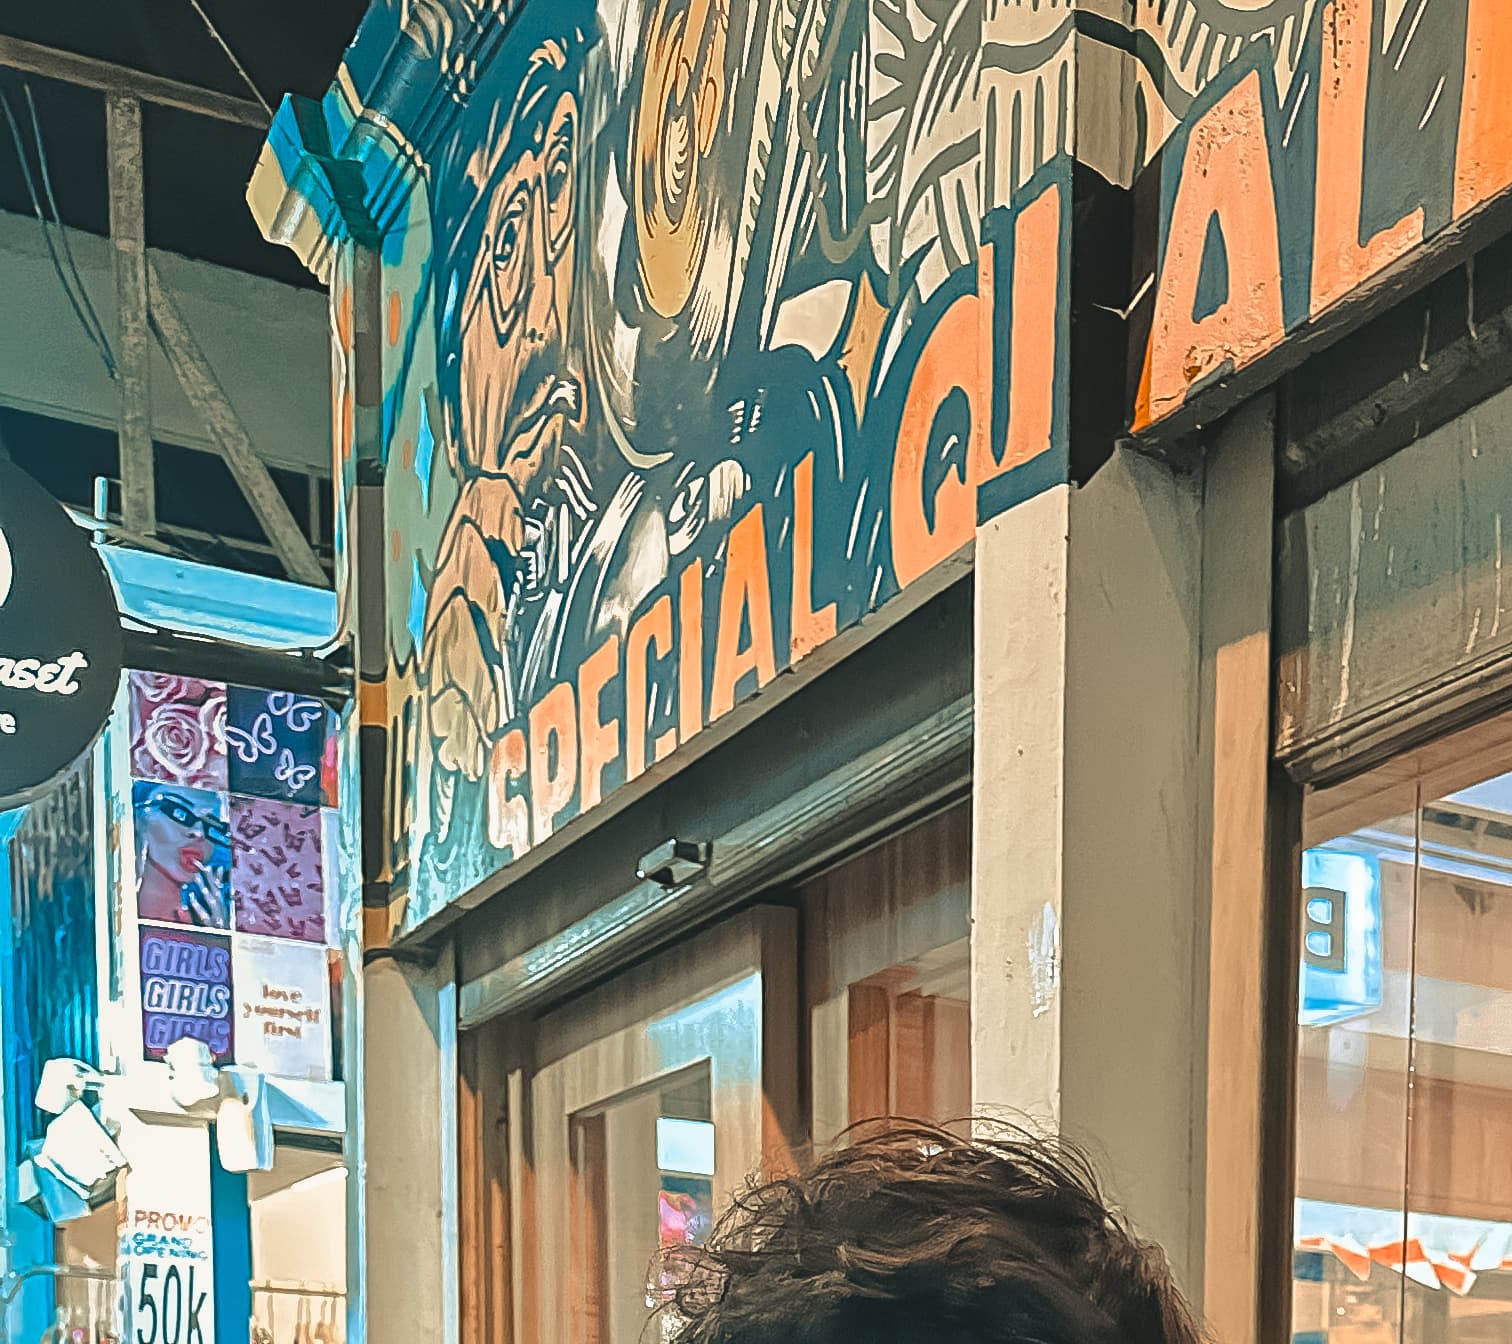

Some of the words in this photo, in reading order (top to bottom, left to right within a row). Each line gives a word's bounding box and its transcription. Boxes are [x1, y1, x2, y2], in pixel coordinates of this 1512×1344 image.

[488, 449, 839, 852] SPECIAL
[142, 937, 230, 982] GIRLS
[144, 977, 231, 1019] GIRLS
